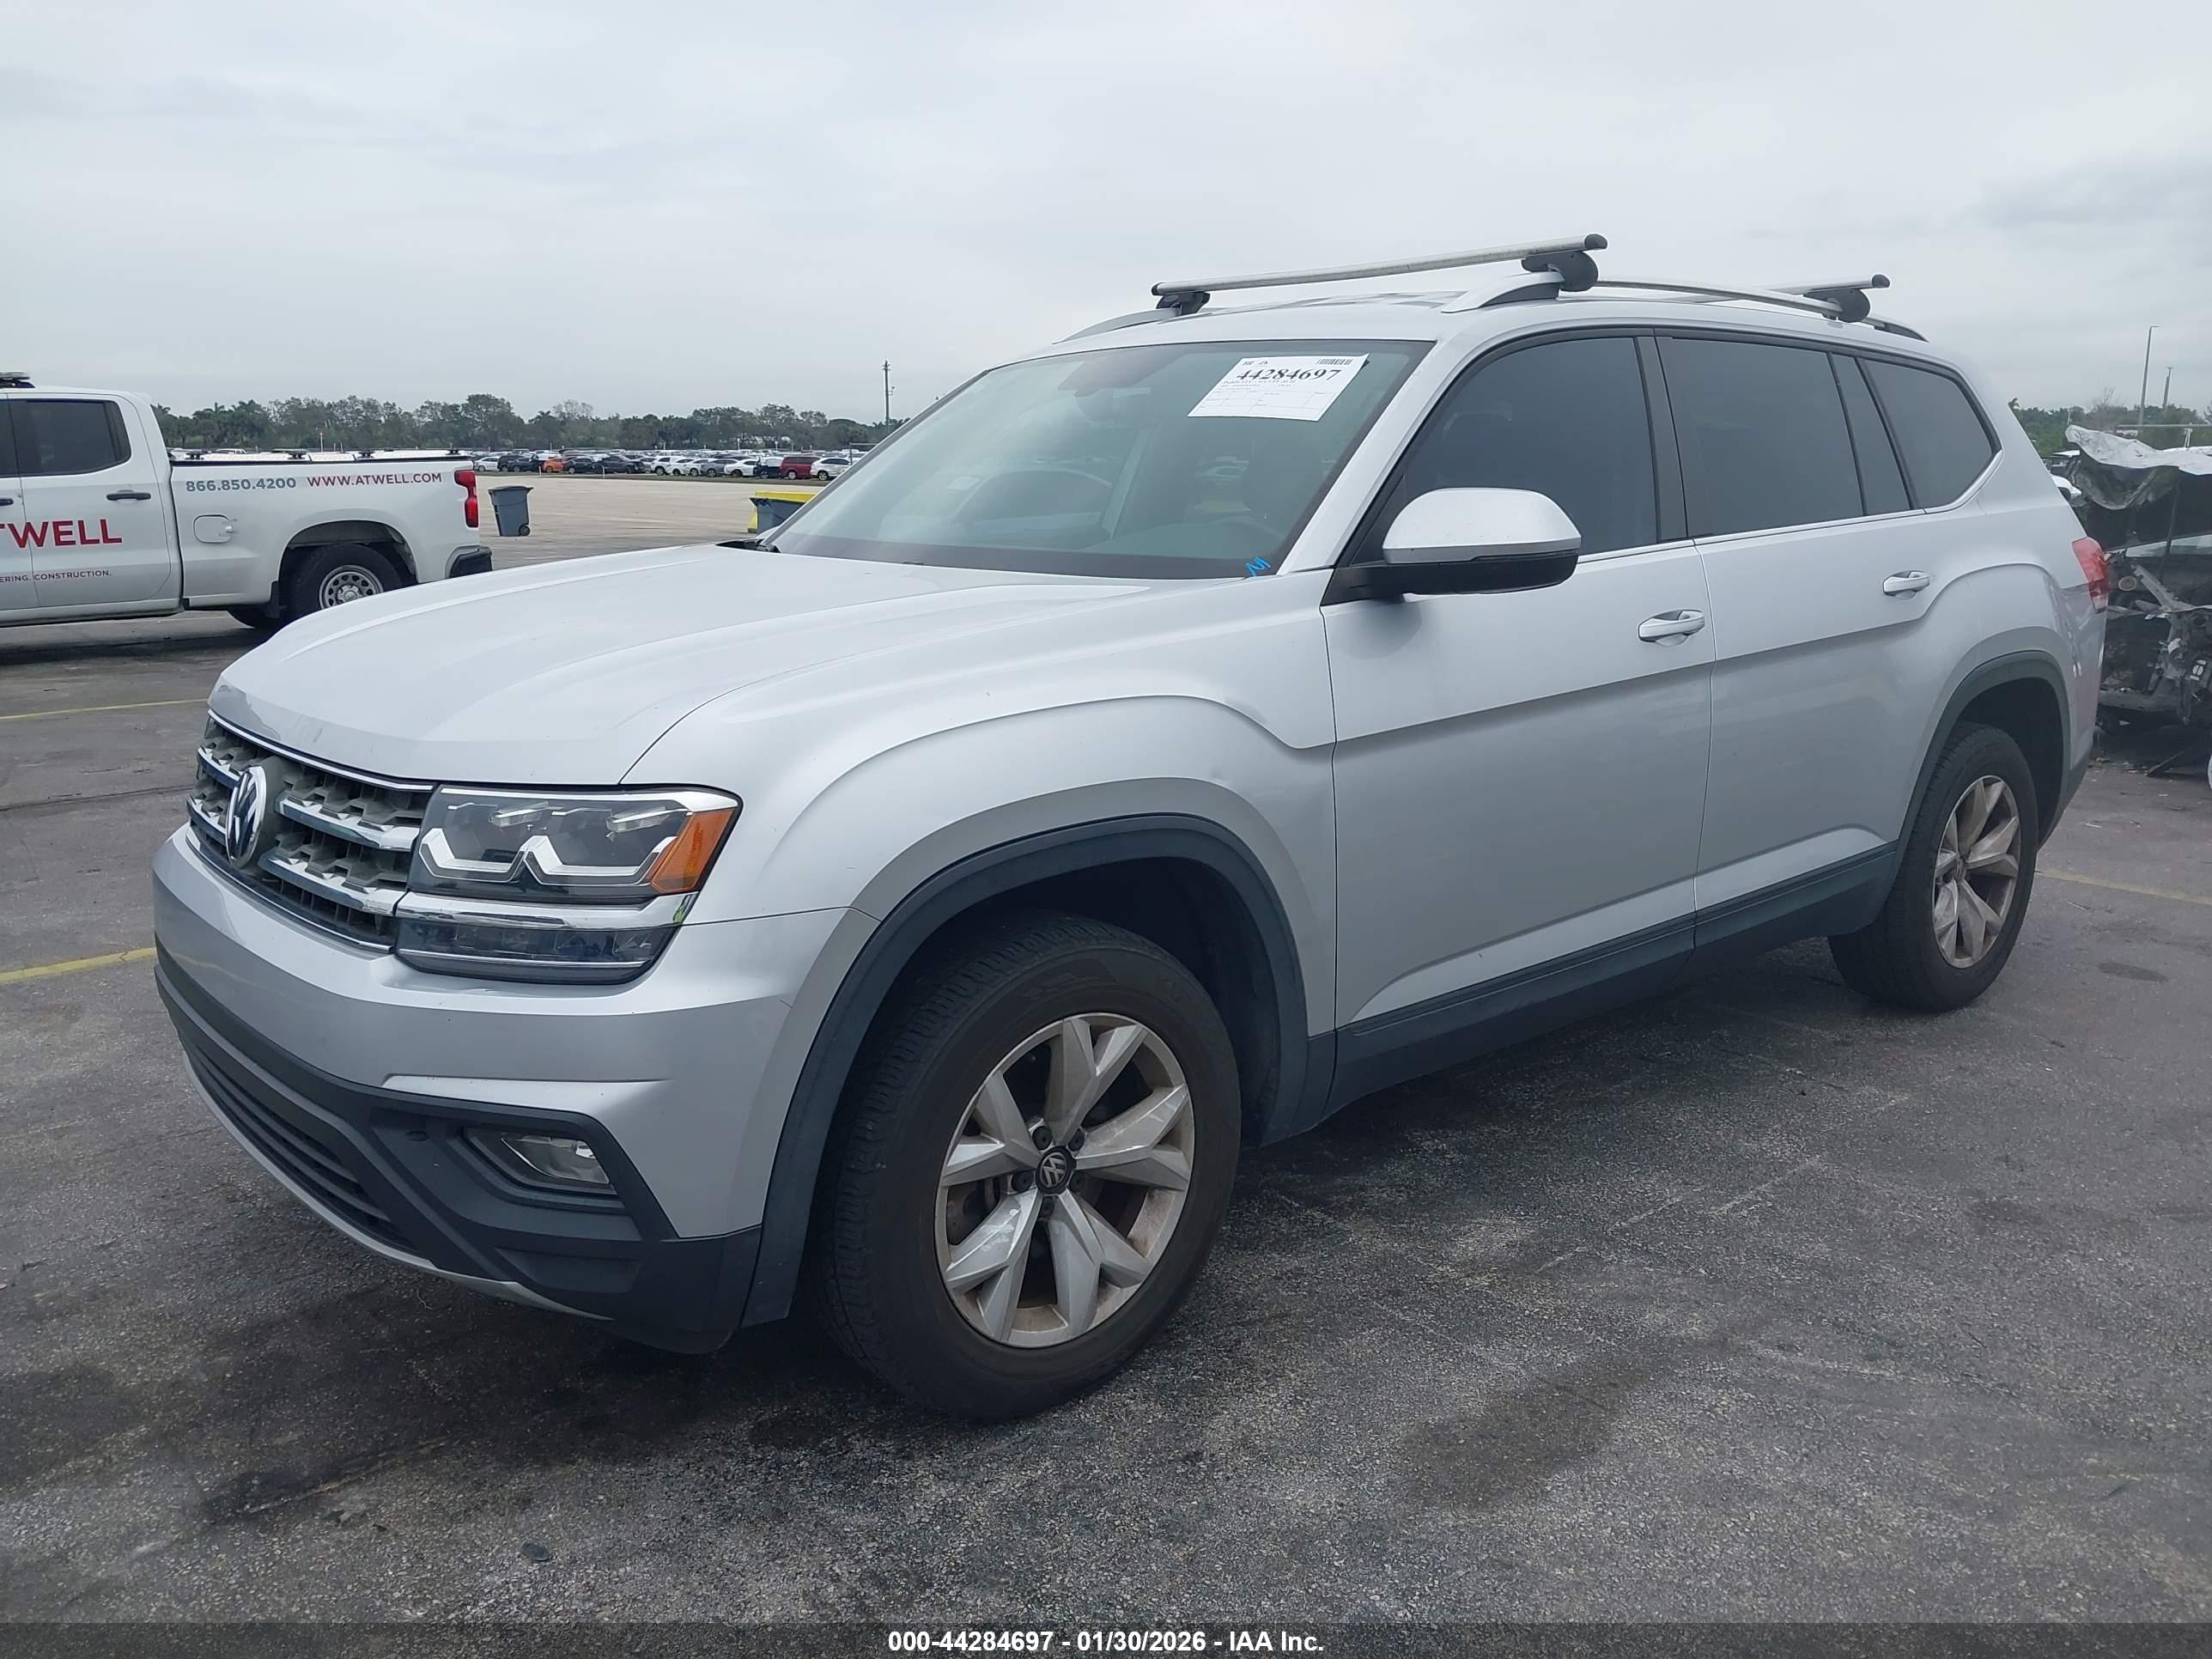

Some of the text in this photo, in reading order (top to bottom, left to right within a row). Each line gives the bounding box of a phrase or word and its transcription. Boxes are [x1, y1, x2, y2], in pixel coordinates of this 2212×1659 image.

[1237, 368, 1341, 381] 44284697
[185, 473, 441, 492] 866.850.4200 WWW.ATWELL.COM
[0, 520, 123, 548] WELL
[34, 570, 112, 580] CONSTRUCTION.
